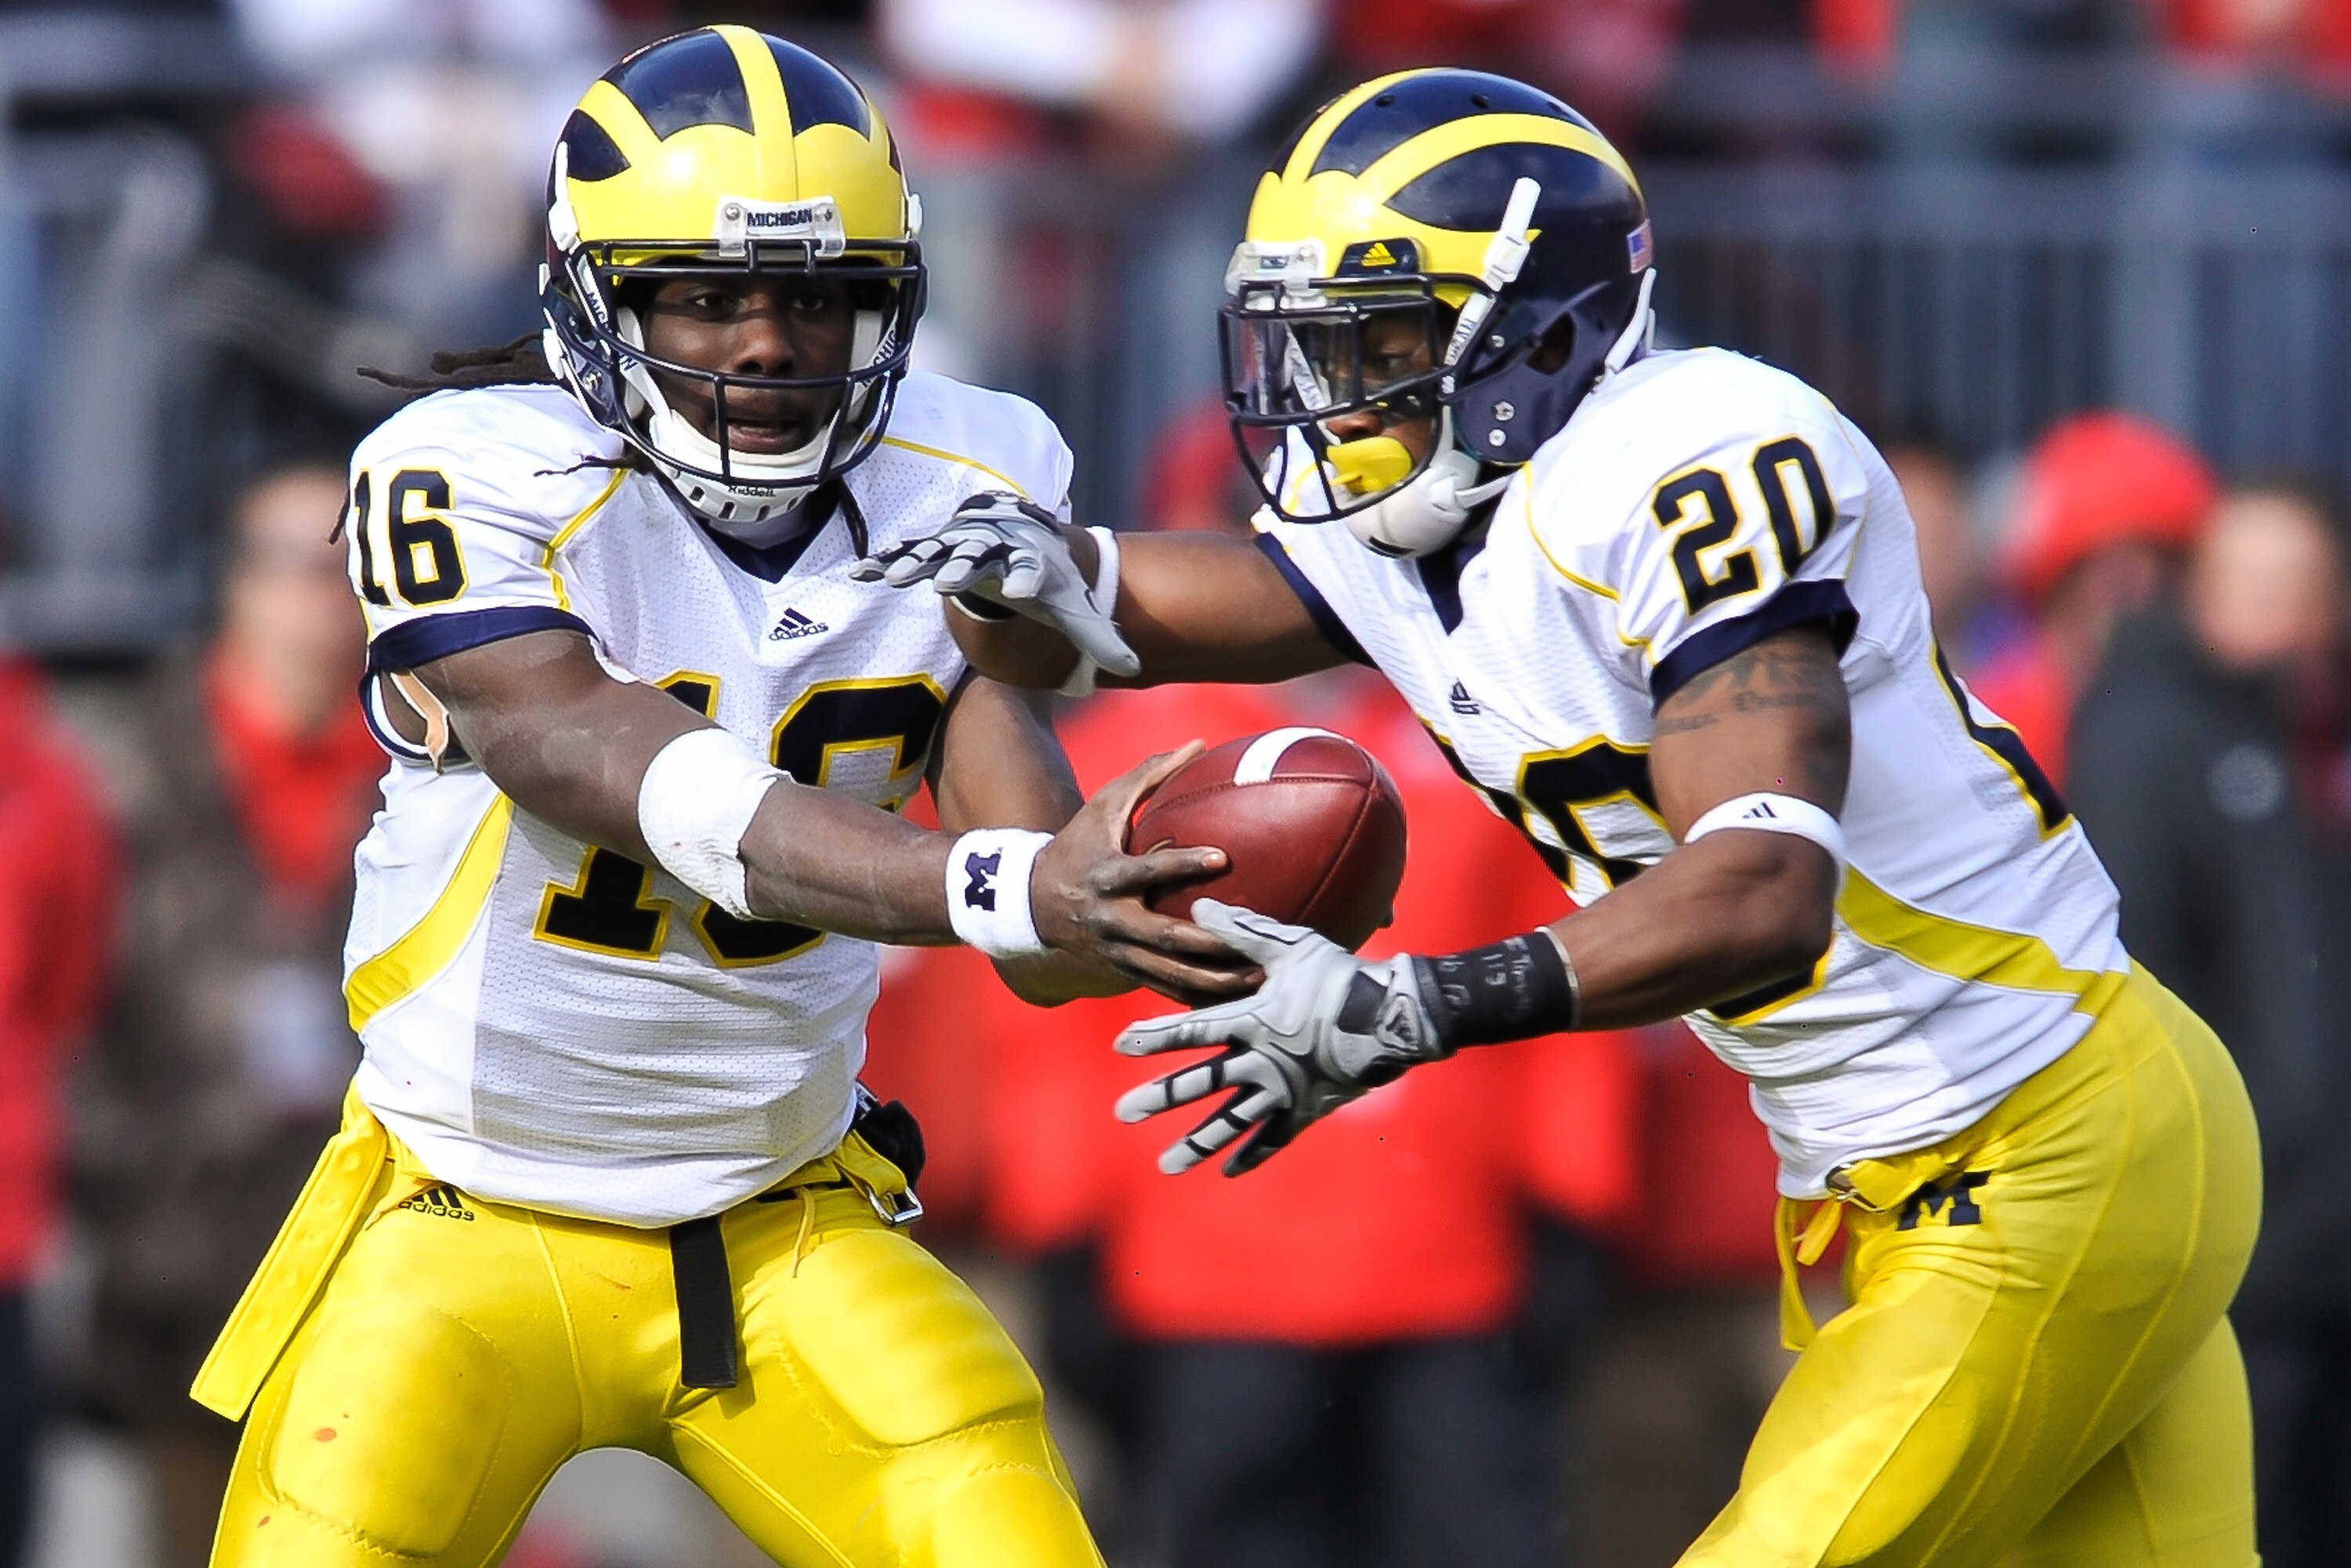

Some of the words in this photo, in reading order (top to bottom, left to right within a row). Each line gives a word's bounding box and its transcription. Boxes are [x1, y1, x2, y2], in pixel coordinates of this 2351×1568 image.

[747, 208, 812, 227] MICHIGAN
[353, 466, 471, 610] 16
[1650, 433, 1836, 618] 20
[768, 622, 829, 641] adidas
[965, 852, 1002, 912] M
[397, 1200, 474, 1222] adidas
[1894, 1170, 1993, 1231] M
